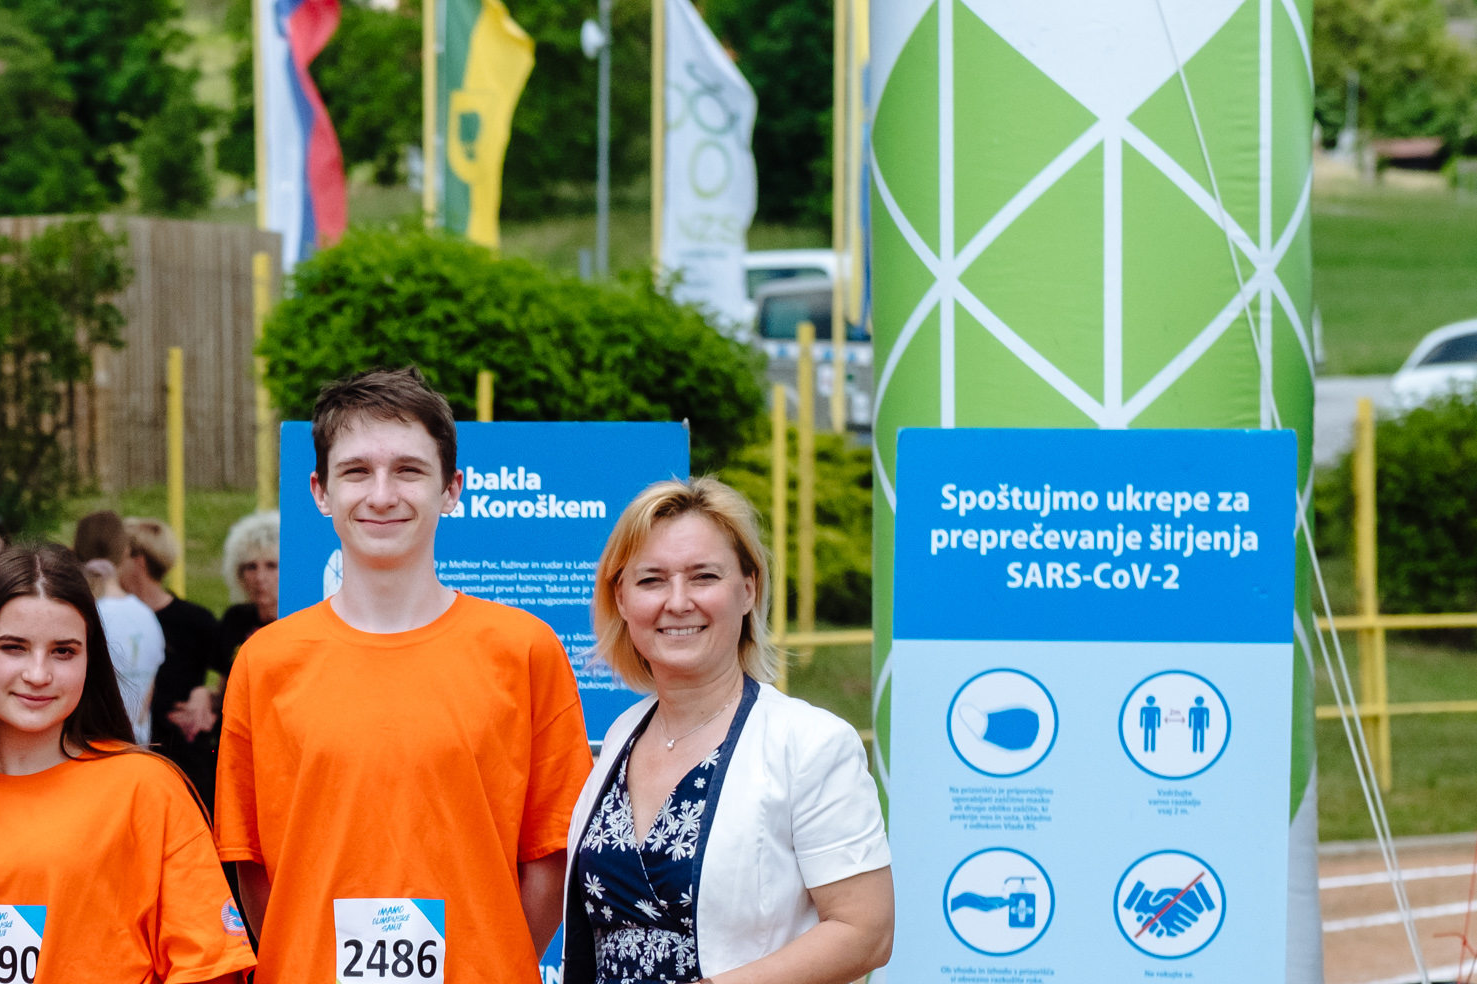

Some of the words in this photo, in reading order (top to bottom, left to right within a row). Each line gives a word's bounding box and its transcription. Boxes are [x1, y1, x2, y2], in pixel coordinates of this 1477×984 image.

[466, 466, 542, 490] bakla
[440, 500, 465, 518] a
[471, 494, 607, 518] Koroškem
[941, 483, 1098, 517] Spoštujmo
[1107, 485, 1210, 518] ukrepe
[1218, 492, 1250, 512] za
[931, 523, 1141, 557] preprečevanje
[1150, 523, 1259, 558] širjenja
[531, 561, 539, 569] in
[541, 560, 563, 569] rudar
[1006, 562, 1180, 590] SARS-CoV-2
[438, 572, 480, 580] Koroškem
[481, 573, 517, 582] prenesel
[518, 572, 558, 582] koncesijo
[570, 572, 586, 581] dve
[461, 584, 494, 594] postavil
[495, 586, 515, 595] prve
[545, 584, 570, 593] Takrat
[581, 585, 590, 595] je
[377, 905, 405, 916] IMAMO
[343, 939, 438, 979] 2486
